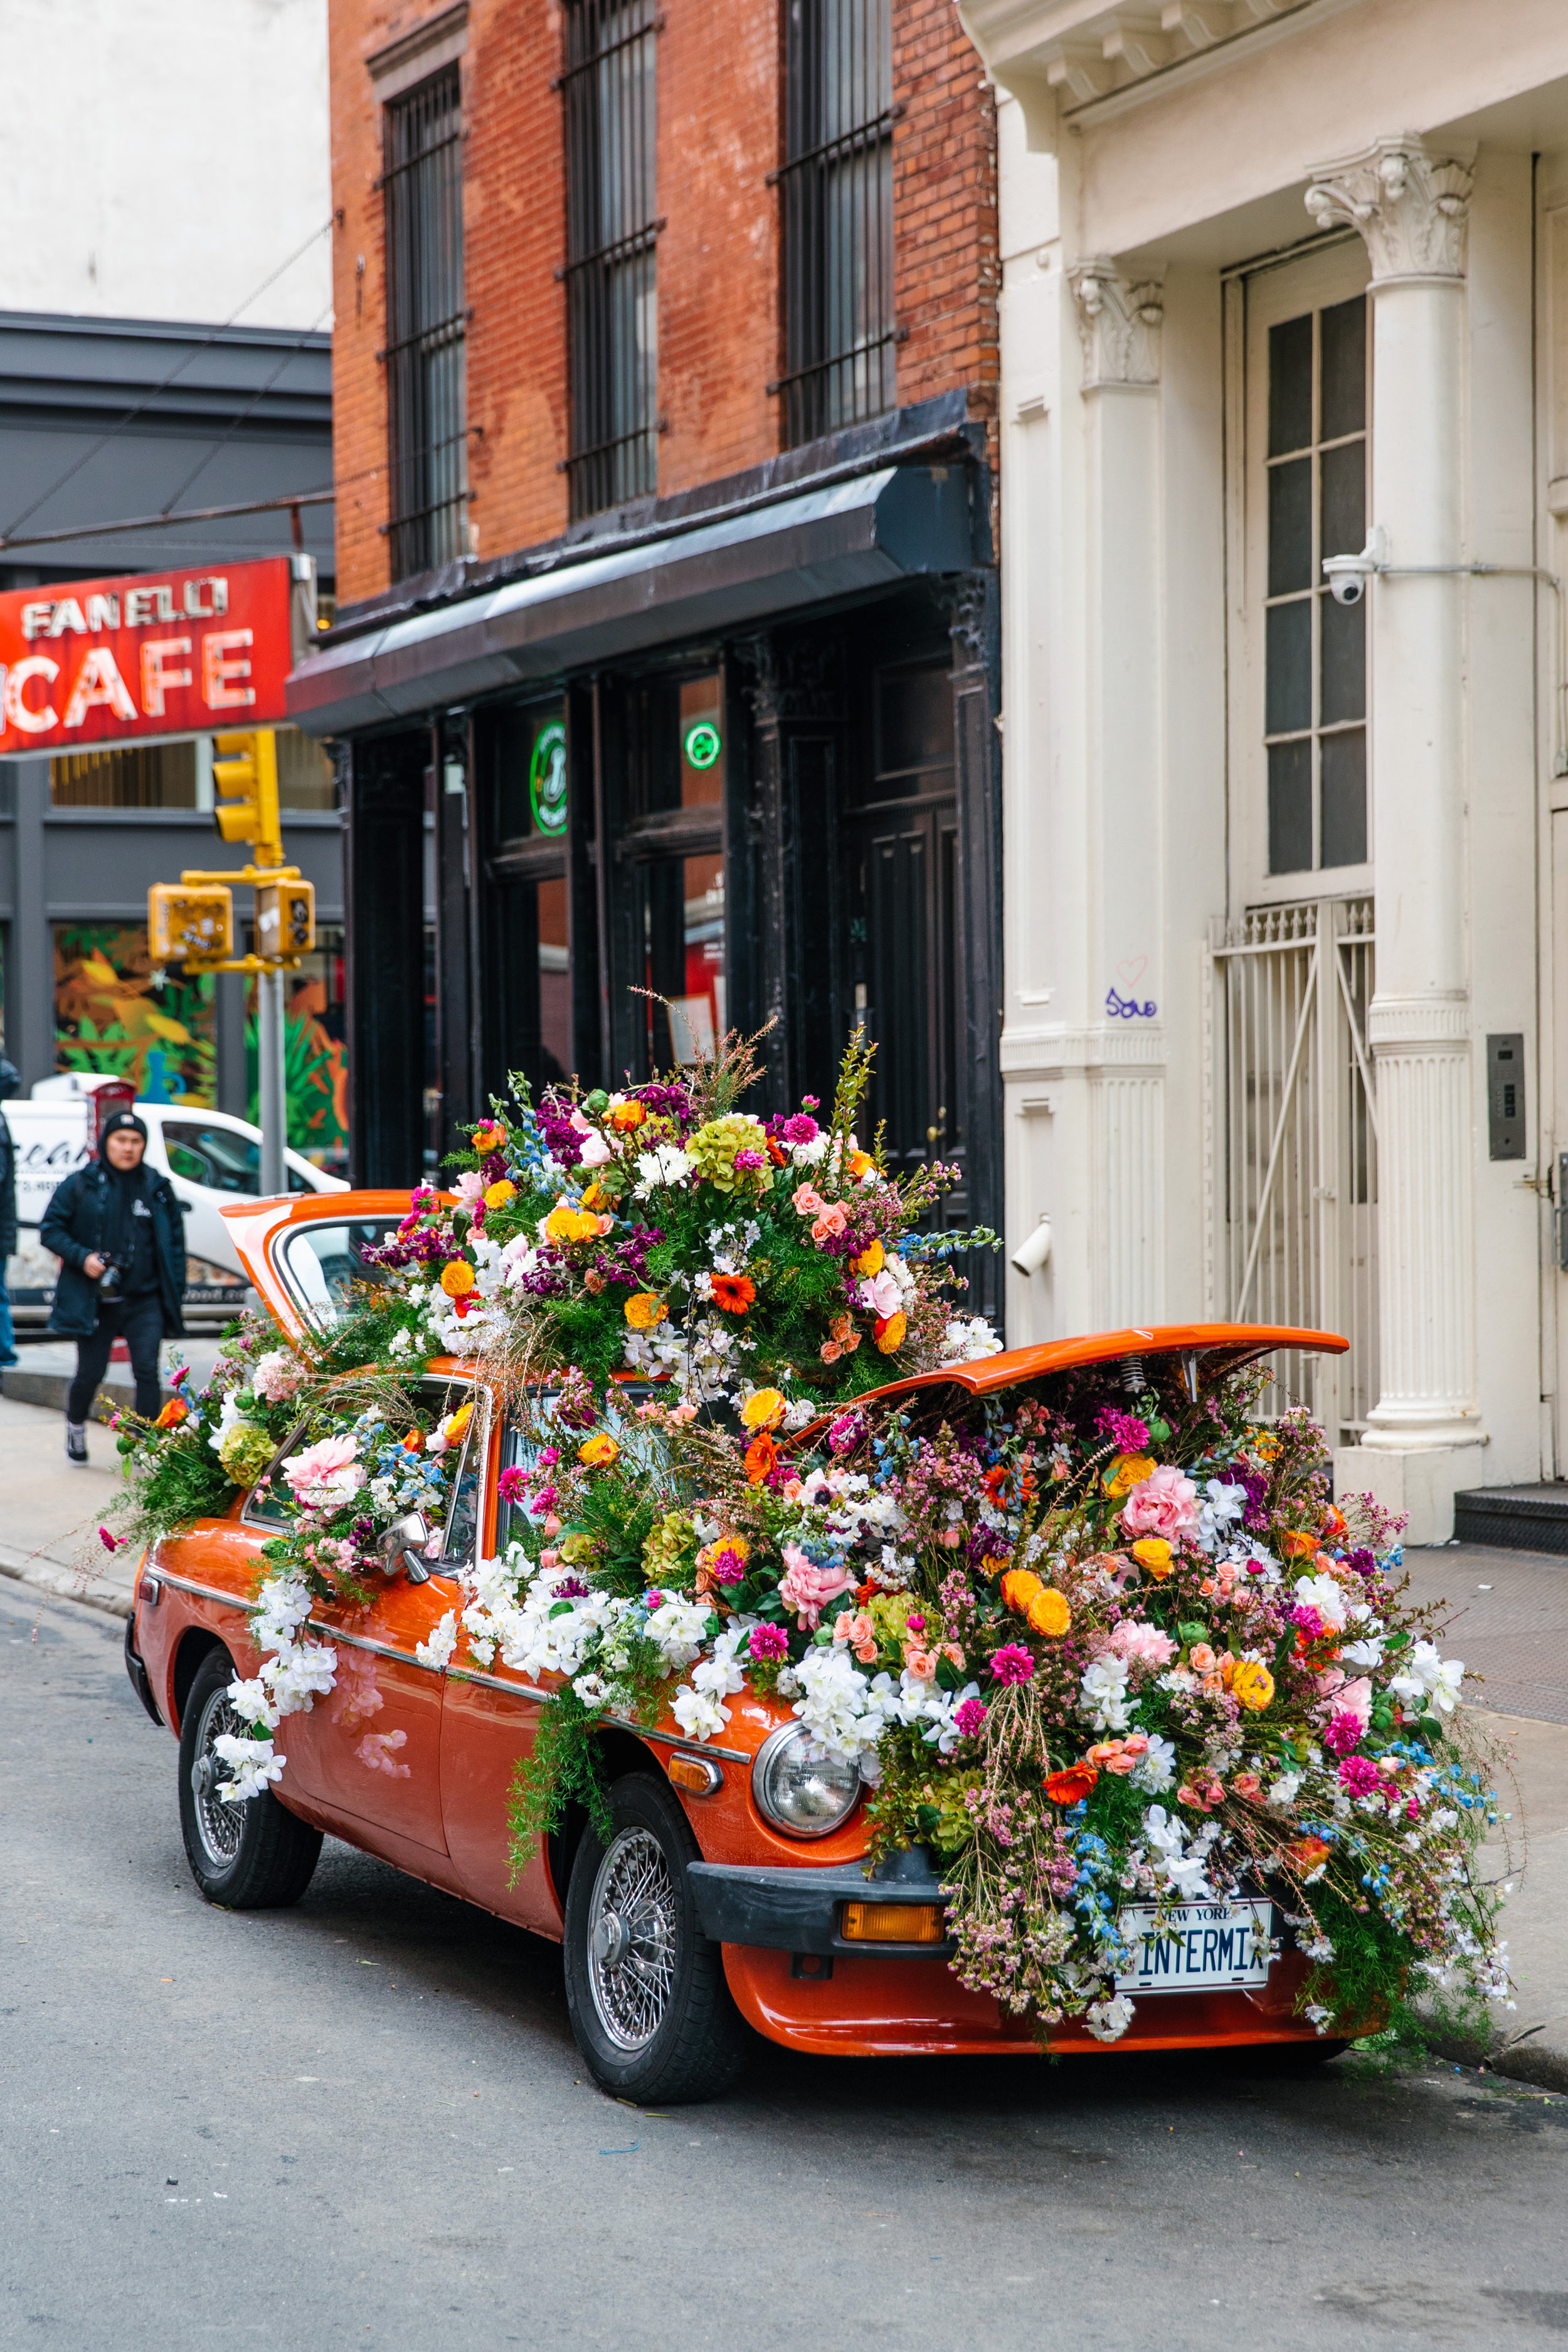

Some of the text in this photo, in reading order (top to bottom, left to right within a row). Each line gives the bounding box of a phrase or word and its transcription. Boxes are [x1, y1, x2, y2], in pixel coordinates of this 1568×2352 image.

[21, 576, 228, 641] FANELLI
[5, 628, 256, 733] CAFE
[1195, 1907, 1232, 1920] YORK
[1138, 1926, 1265, 1975] INTERMIX
